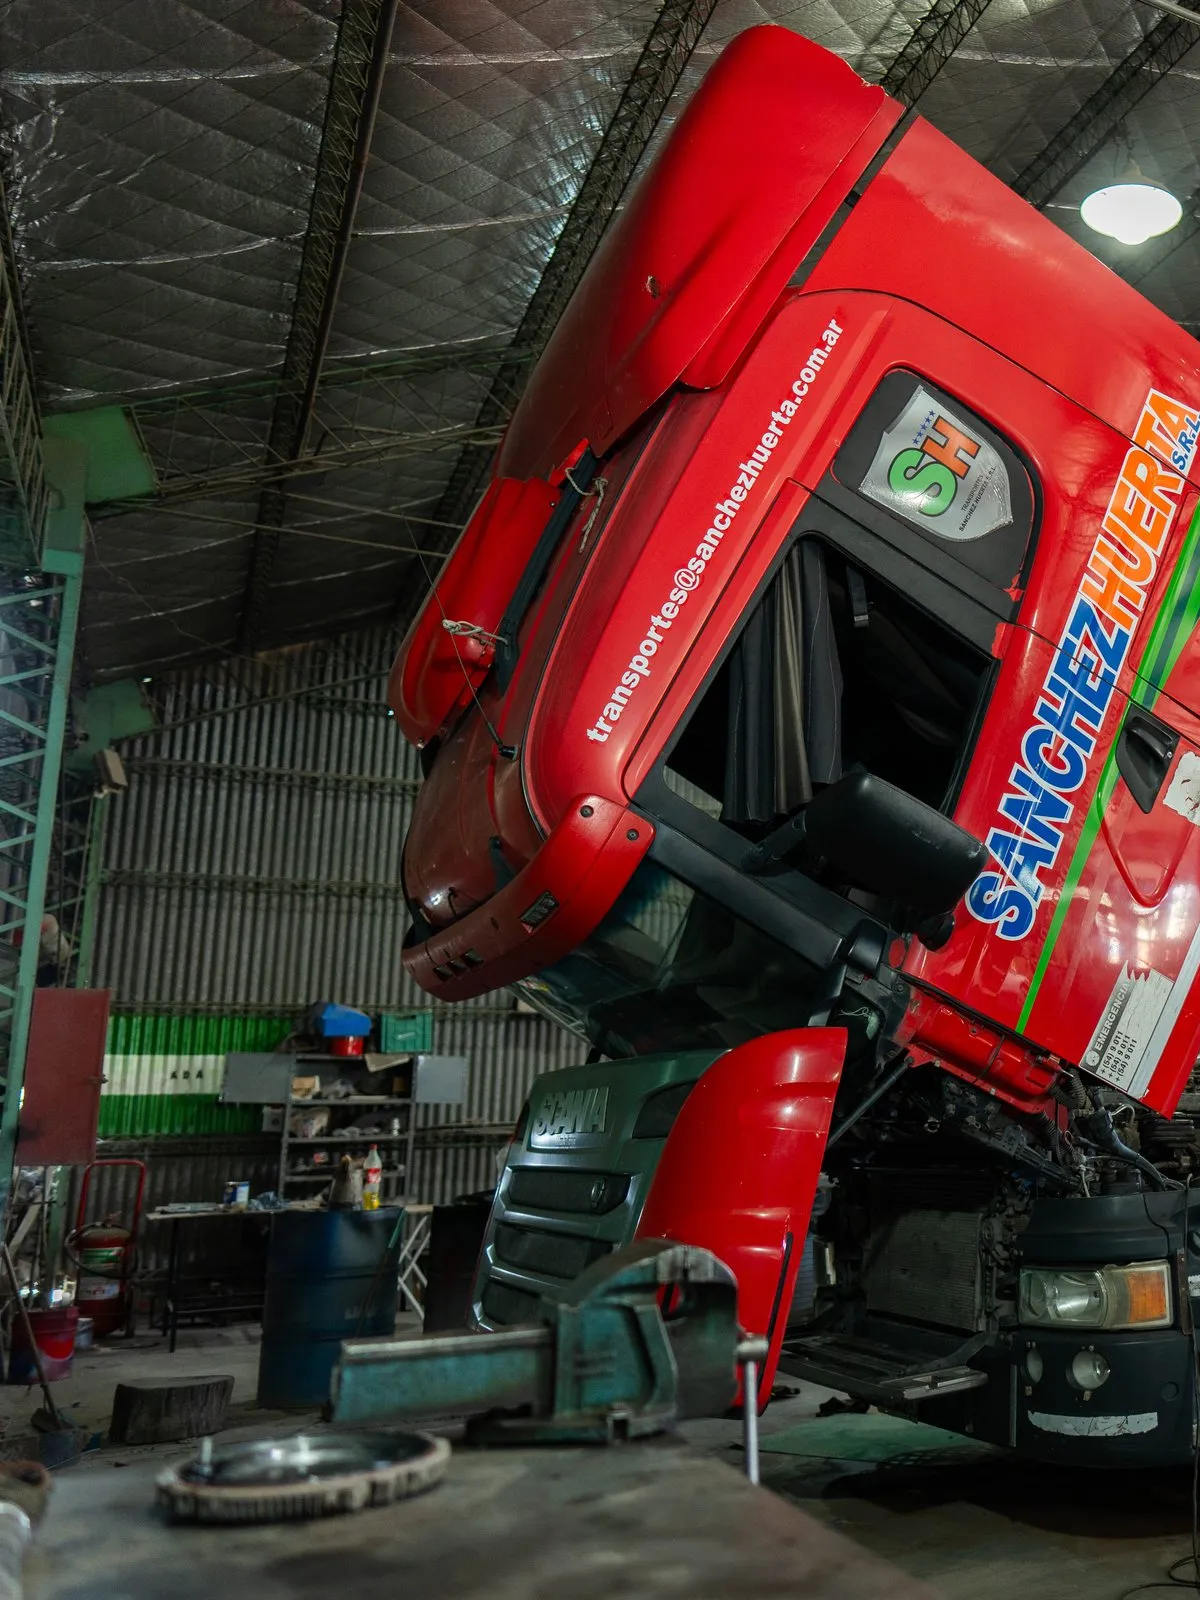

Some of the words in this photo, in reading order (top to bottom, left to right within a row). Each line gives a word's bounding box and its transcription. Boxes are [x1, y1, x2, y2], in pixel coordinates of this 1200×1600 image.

[887, 415, 982, 517] SH
[958, 503, 976, 531] SANCHEZ
[973, 480, 989, 503] HUERTA
[961, 474, 983, 511] TRANSPORTES
[586, 318, 844, 745] transportes@sanchezhuerta.com.ar
[1114, 1031, 1123, 1044] 011
[1121, 1035, 1130, 1049] 011
[1128, 1039, 1137, 1053] 011
[534, 1085, 610, 1136] SCANIA
